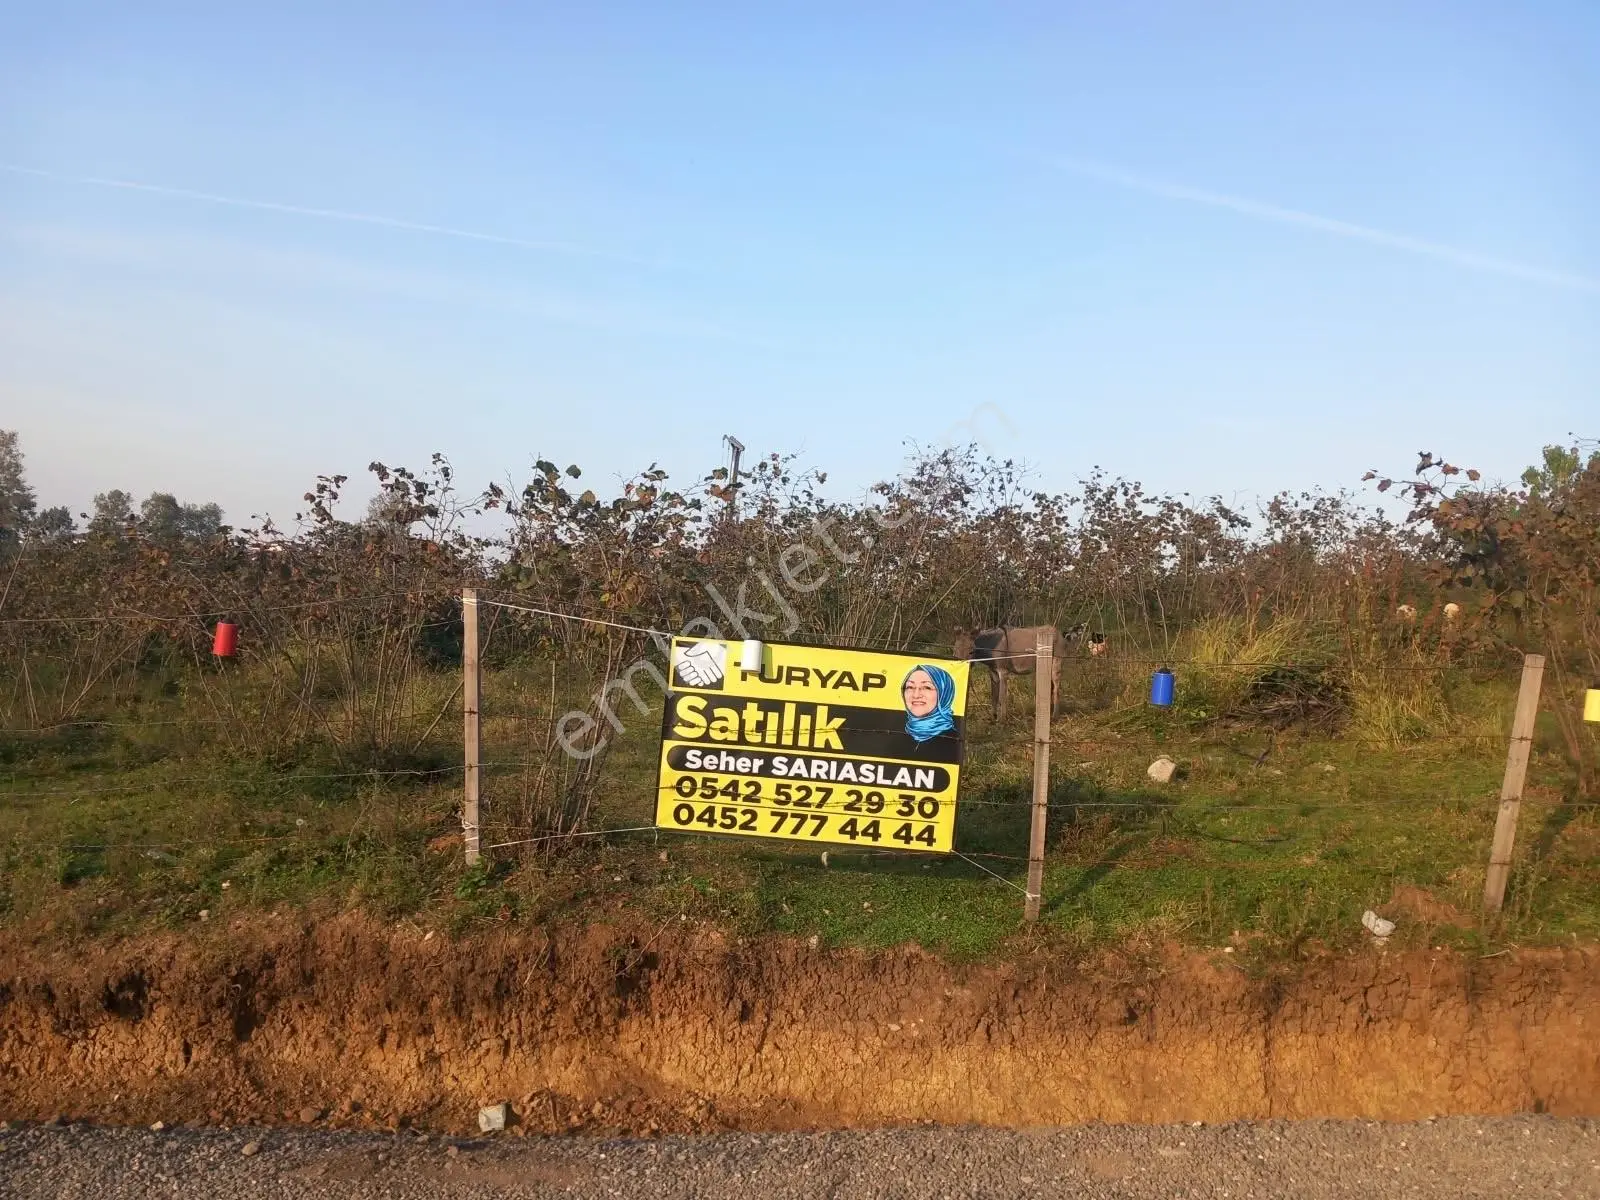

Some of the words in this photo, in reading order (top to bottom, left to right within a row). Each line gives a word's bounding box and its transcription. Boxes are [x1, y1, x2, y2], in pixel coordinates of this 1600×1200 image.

[672, 695, 847, 750] Satılık
[684, 749, 764, 774] Seher
[771, 756, 935, 790] SARIASLAN
[674, 775, 762, 804] 0542
[772, 783, 834, 810] 527
[843, 789, 885, 814] 29
[895, 794, 940, 820] 30
[672, 803, 759, 832] 0452
[769, 811, 829, 837] 777
[838, 818, 882, 842] 44
[892, 823, 937, 847] 44
